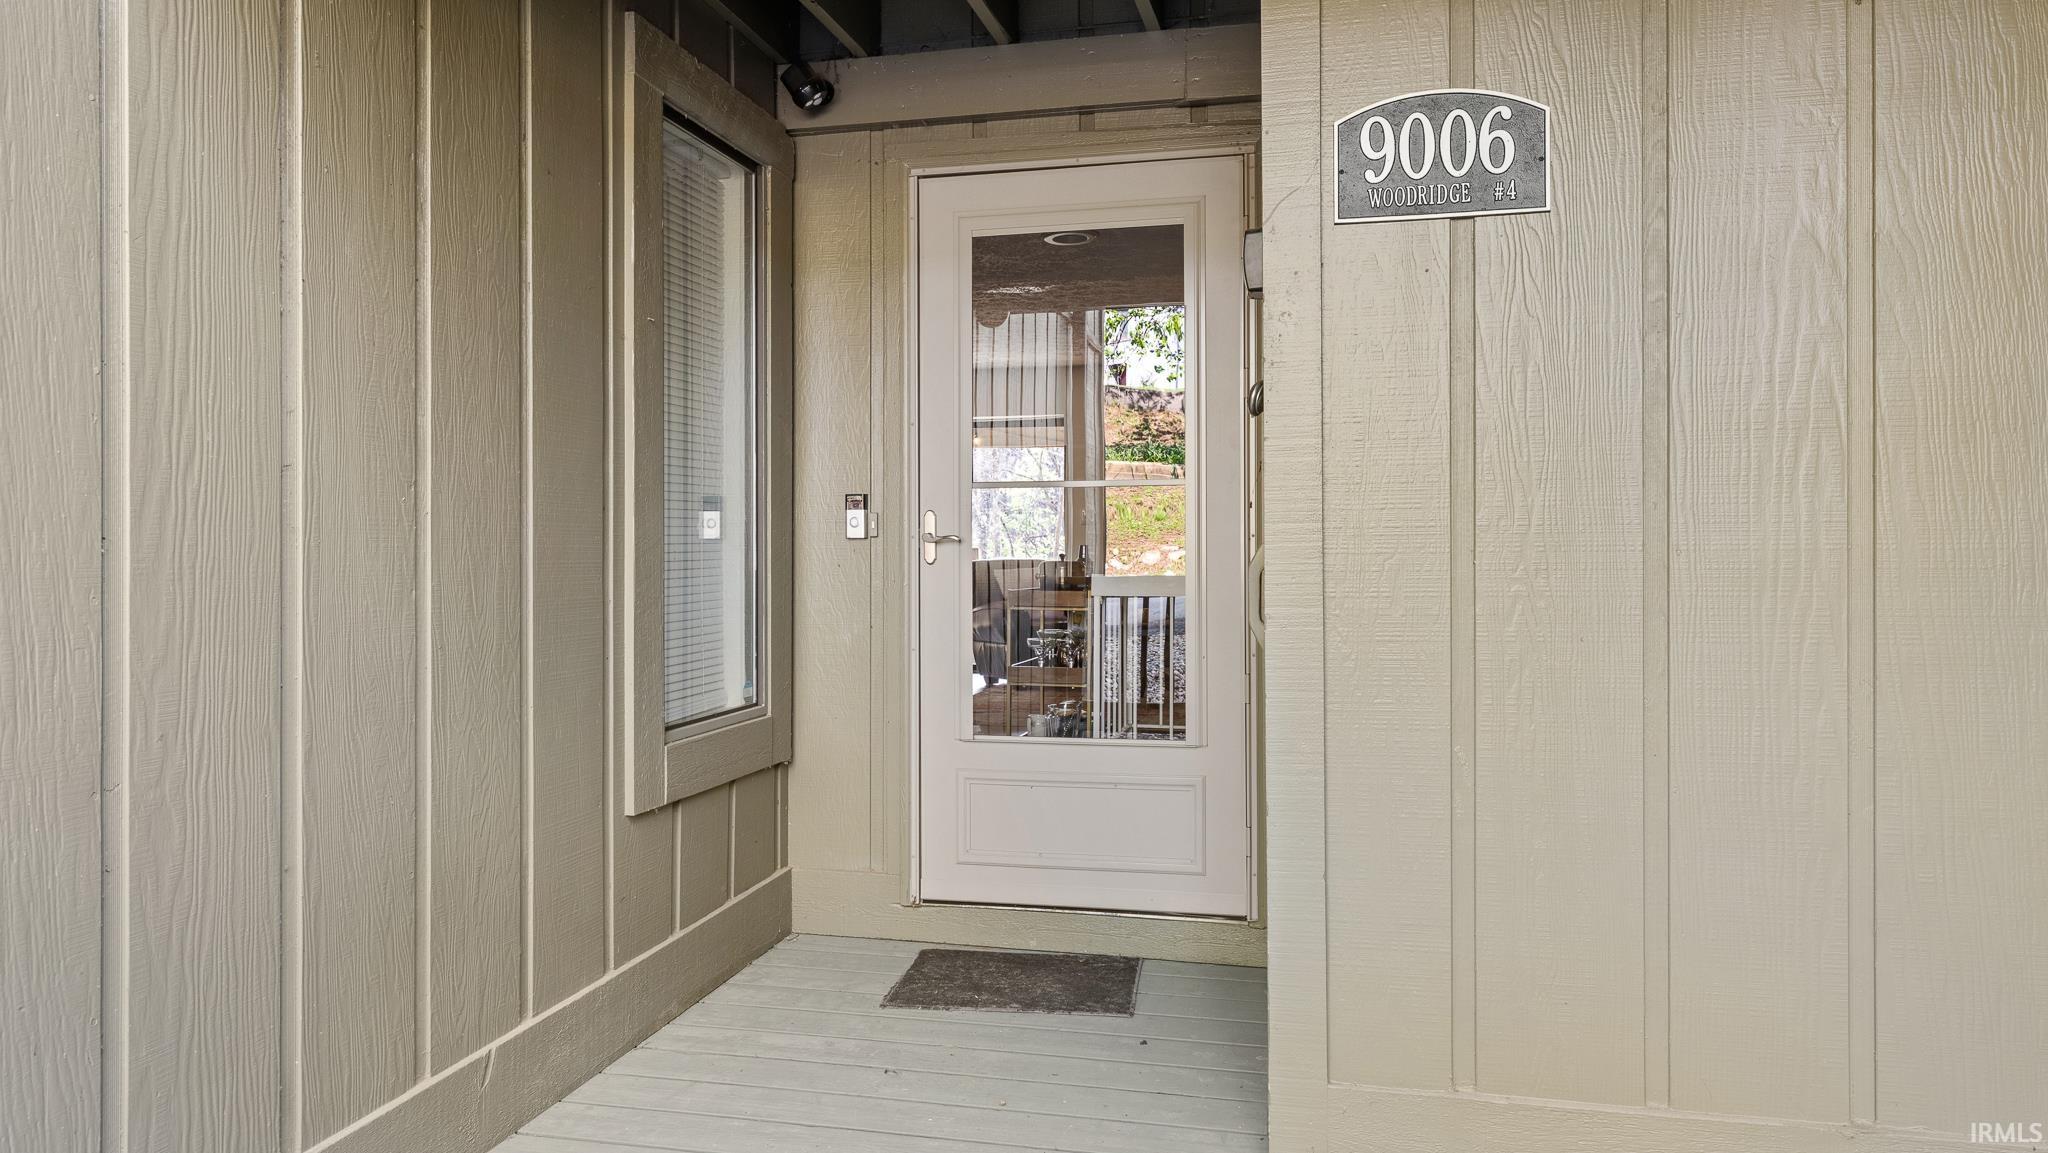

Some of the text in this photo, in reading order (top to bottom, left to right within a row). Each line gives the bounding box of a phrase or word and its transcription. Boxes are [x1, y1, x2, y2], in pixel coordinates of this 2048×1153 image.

[1359, 105, 1516, 184] 9006
[1367, 179, 1517, 208] WOODRIDGE #4
